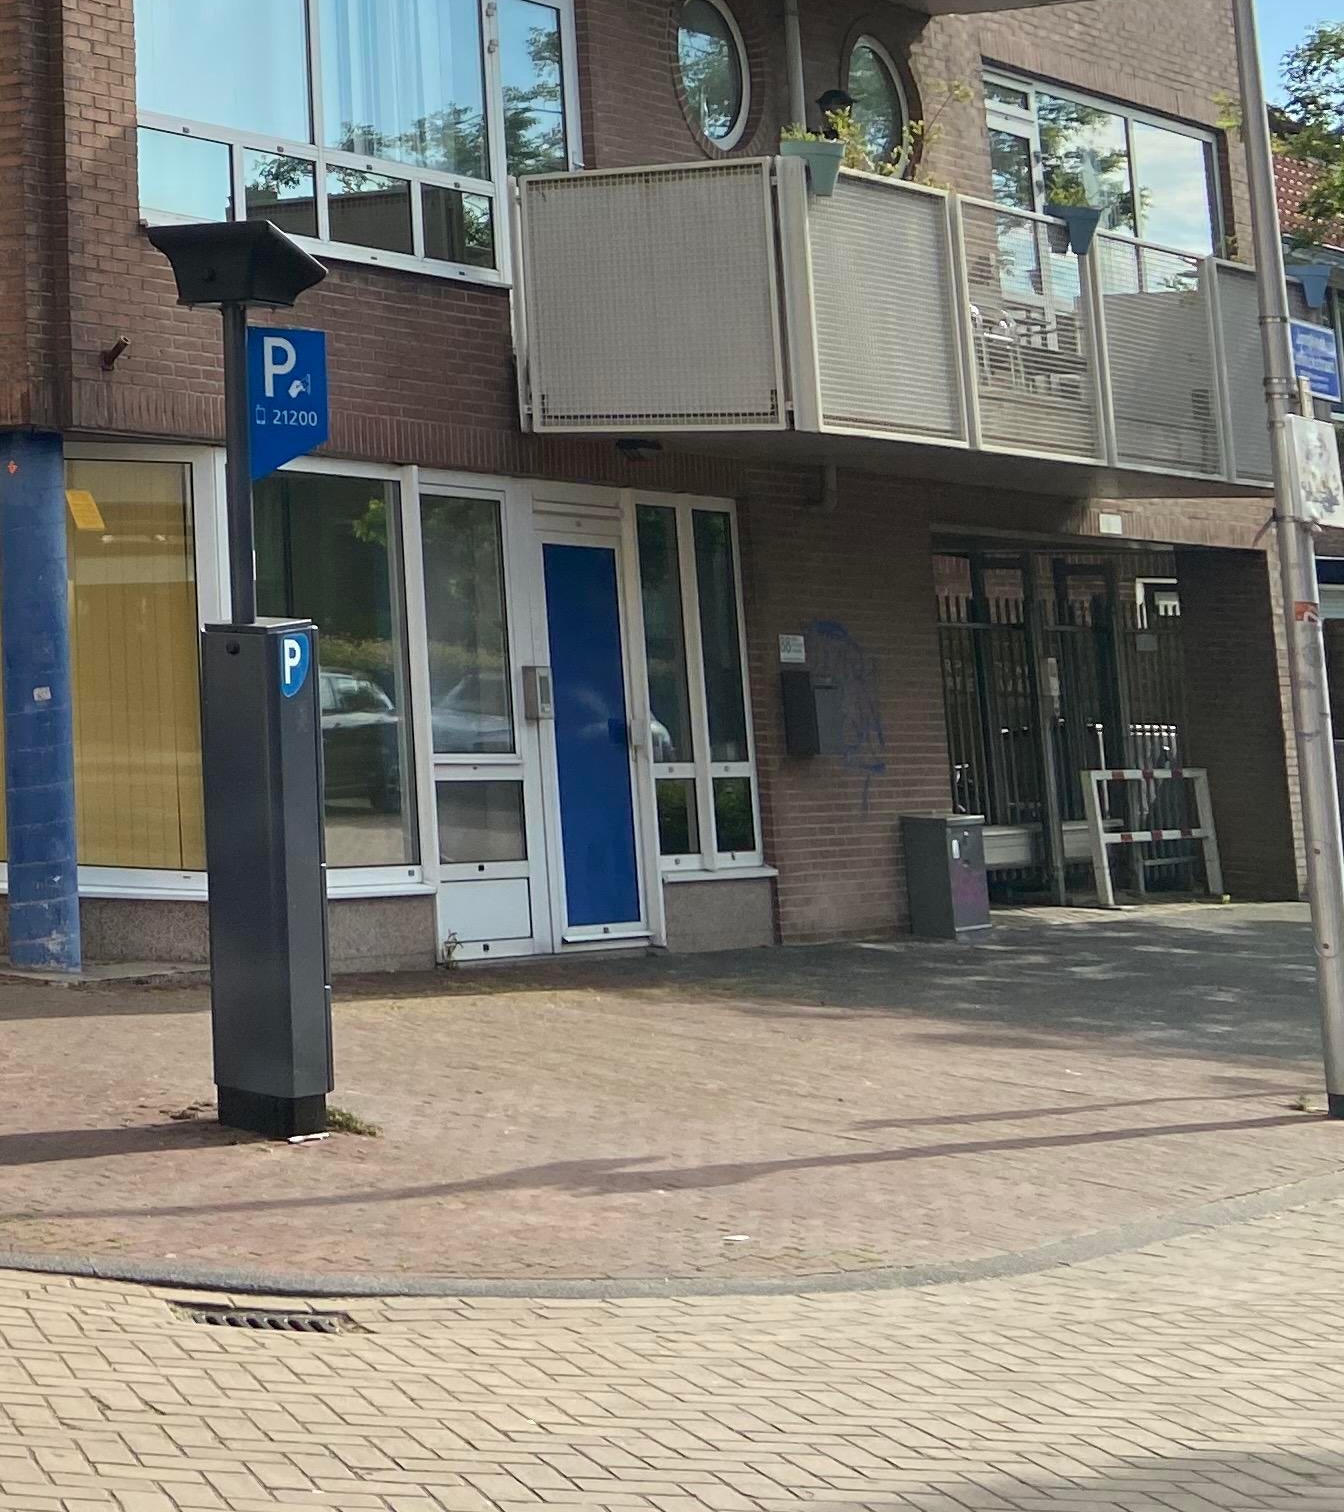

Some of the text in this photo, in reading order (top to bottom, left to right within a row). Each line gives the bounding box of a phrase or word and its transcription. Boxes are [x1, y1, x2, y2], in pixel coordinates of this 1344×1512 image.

[263, 336, 297, 398] P
[272, 409, 318, 427] 21200
[283, 638, 302, 685] P
